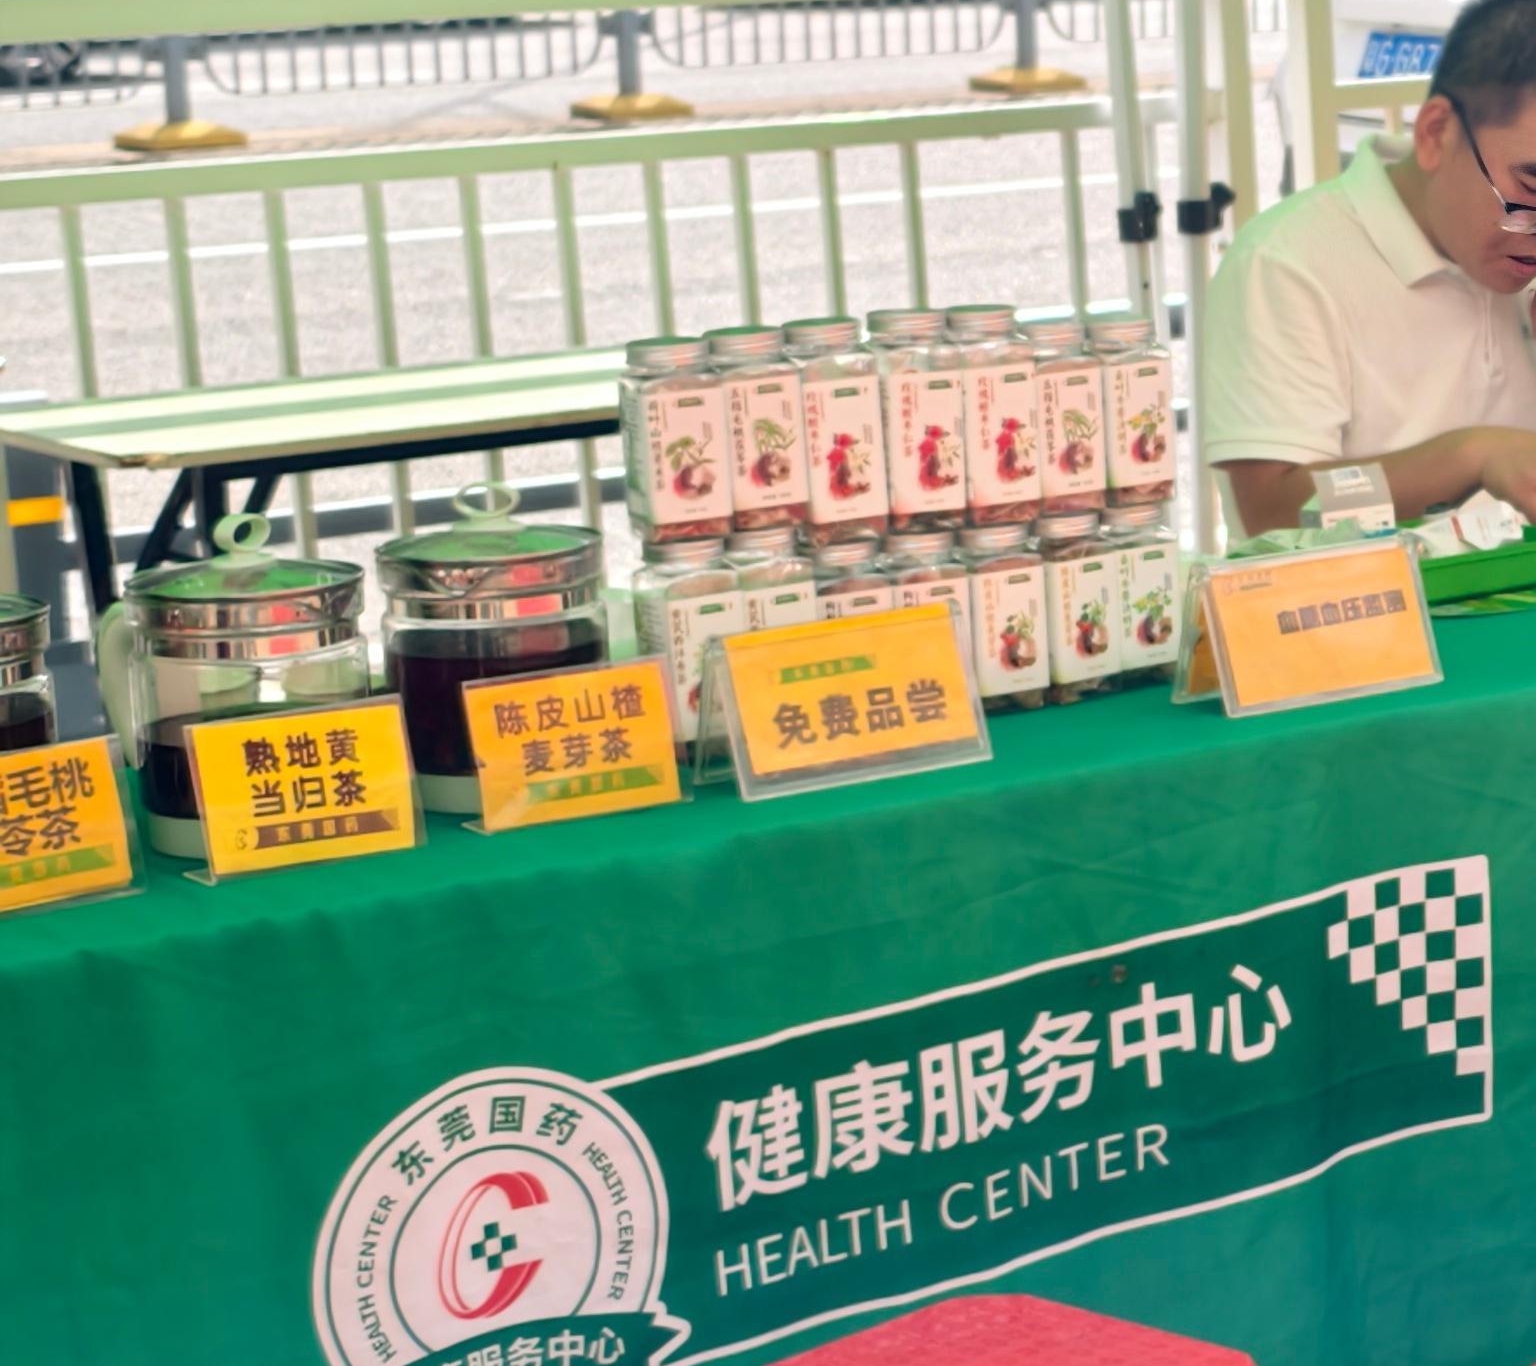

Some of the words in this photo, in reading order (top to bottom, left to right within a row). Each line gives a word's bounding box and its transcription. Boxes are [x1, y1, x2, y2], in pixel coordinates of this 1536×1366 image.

[493, 683, 646, 739] 陈皮山楂
[772, 678, 948, 749] 免费品尝
[242, 728, 360, 777] 熟地黄
[521, 726, 632, 776] 麦芽茶
[251, 770, 367, 818] 当归茶
[705, 962, 1294, 1212] 健康服务中心
[391, 1094, 583, 1188] 东莞国药
[355, 1193, 401, 1288] CENTER
[581, 1141, 628, 1208] HEALTH
[605, 1208, 635, 1301] CENTER
[713, 1200, 915, 1297] HEALTH
[940, 1122, 1172, 1234] CENTER
[354, 1290, 398, 1365] HEALTH
